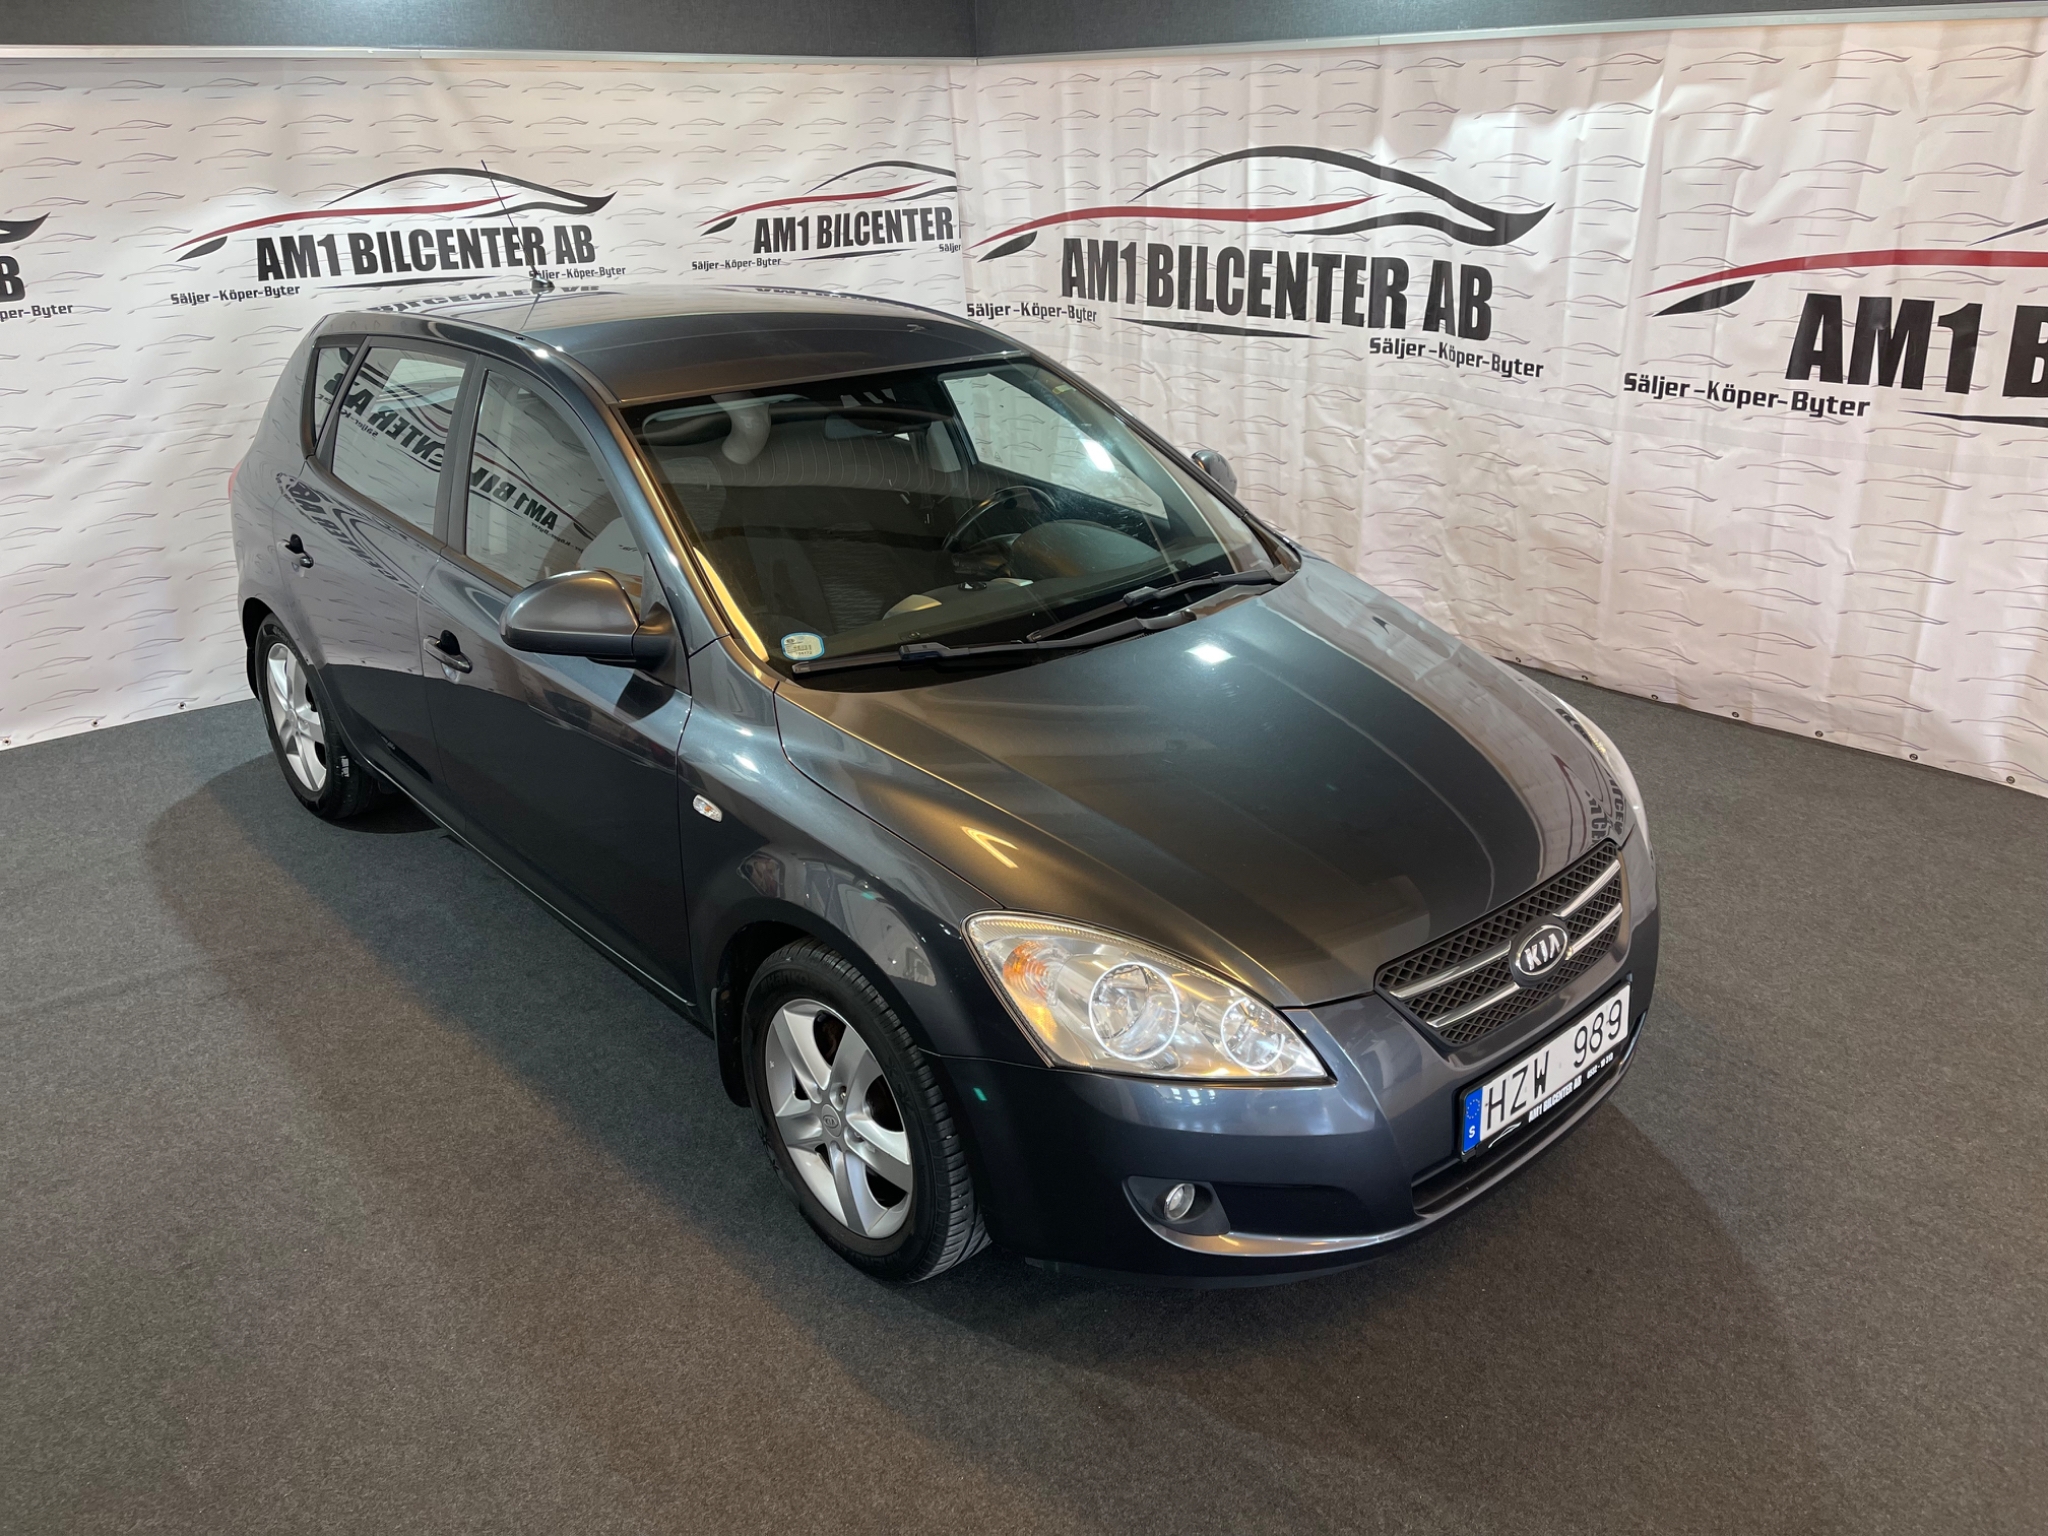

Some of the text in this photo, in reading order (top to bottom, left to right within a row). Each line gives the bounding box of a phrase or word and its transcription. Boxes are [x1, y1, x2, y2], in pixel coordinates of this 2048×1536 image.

[256, 225, 596, 282] AM1 BILCENTER AB
[754, 216, 808, 254] AM1
[816, 207, 954, 250] BILCENTER
[1062, 237, 1493, 341] AM1 BILCENTER AB
[1785, 292, 1983, 395] AM1
[1524, 933, 1560, 971] KIA
[1486, 999, 1623, 1130] HZW 989
[1468, 1126, 1476, 1139] S
